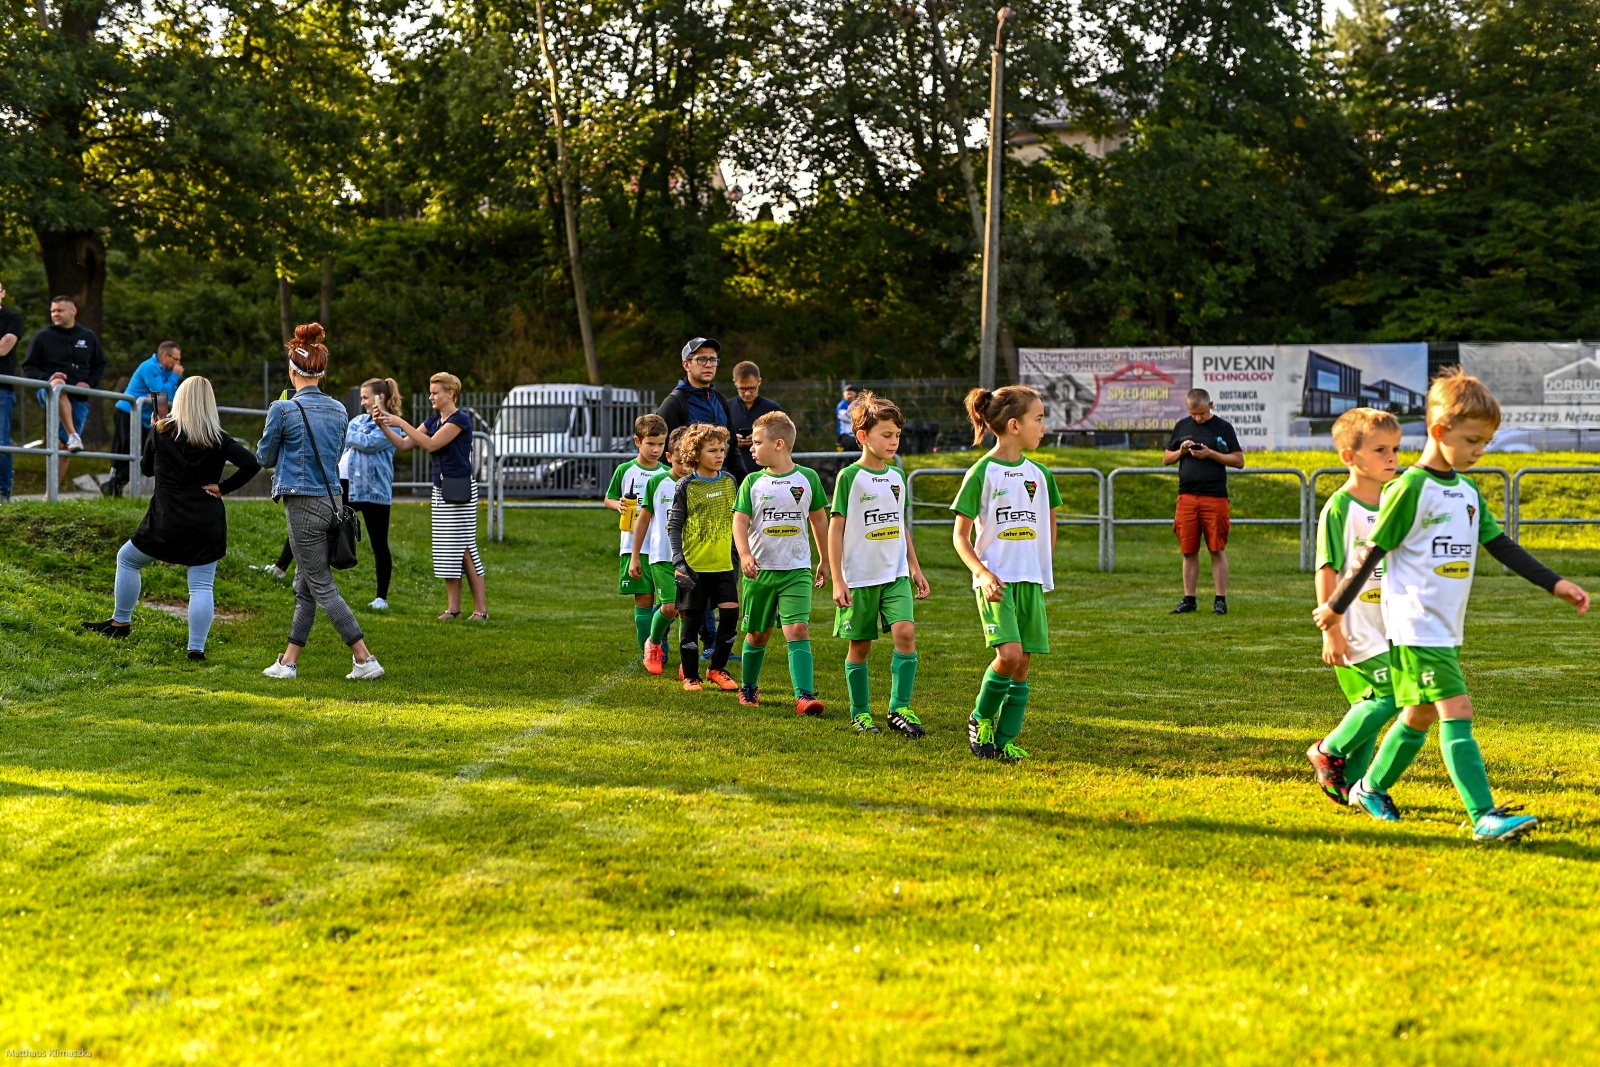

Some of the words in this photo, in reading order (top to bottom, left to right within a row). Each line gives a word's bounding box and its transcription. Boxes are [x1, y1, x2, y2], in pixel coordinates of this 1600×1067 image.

[1203, 356, 1275, 371] PIVEXIN
[1203, 372, 1274, 382] TECHNOLOGY
[1219, 390, 1258, 399] DOSTAWCA
[1235, 427, 1268, 436] ZEMYSŁU
